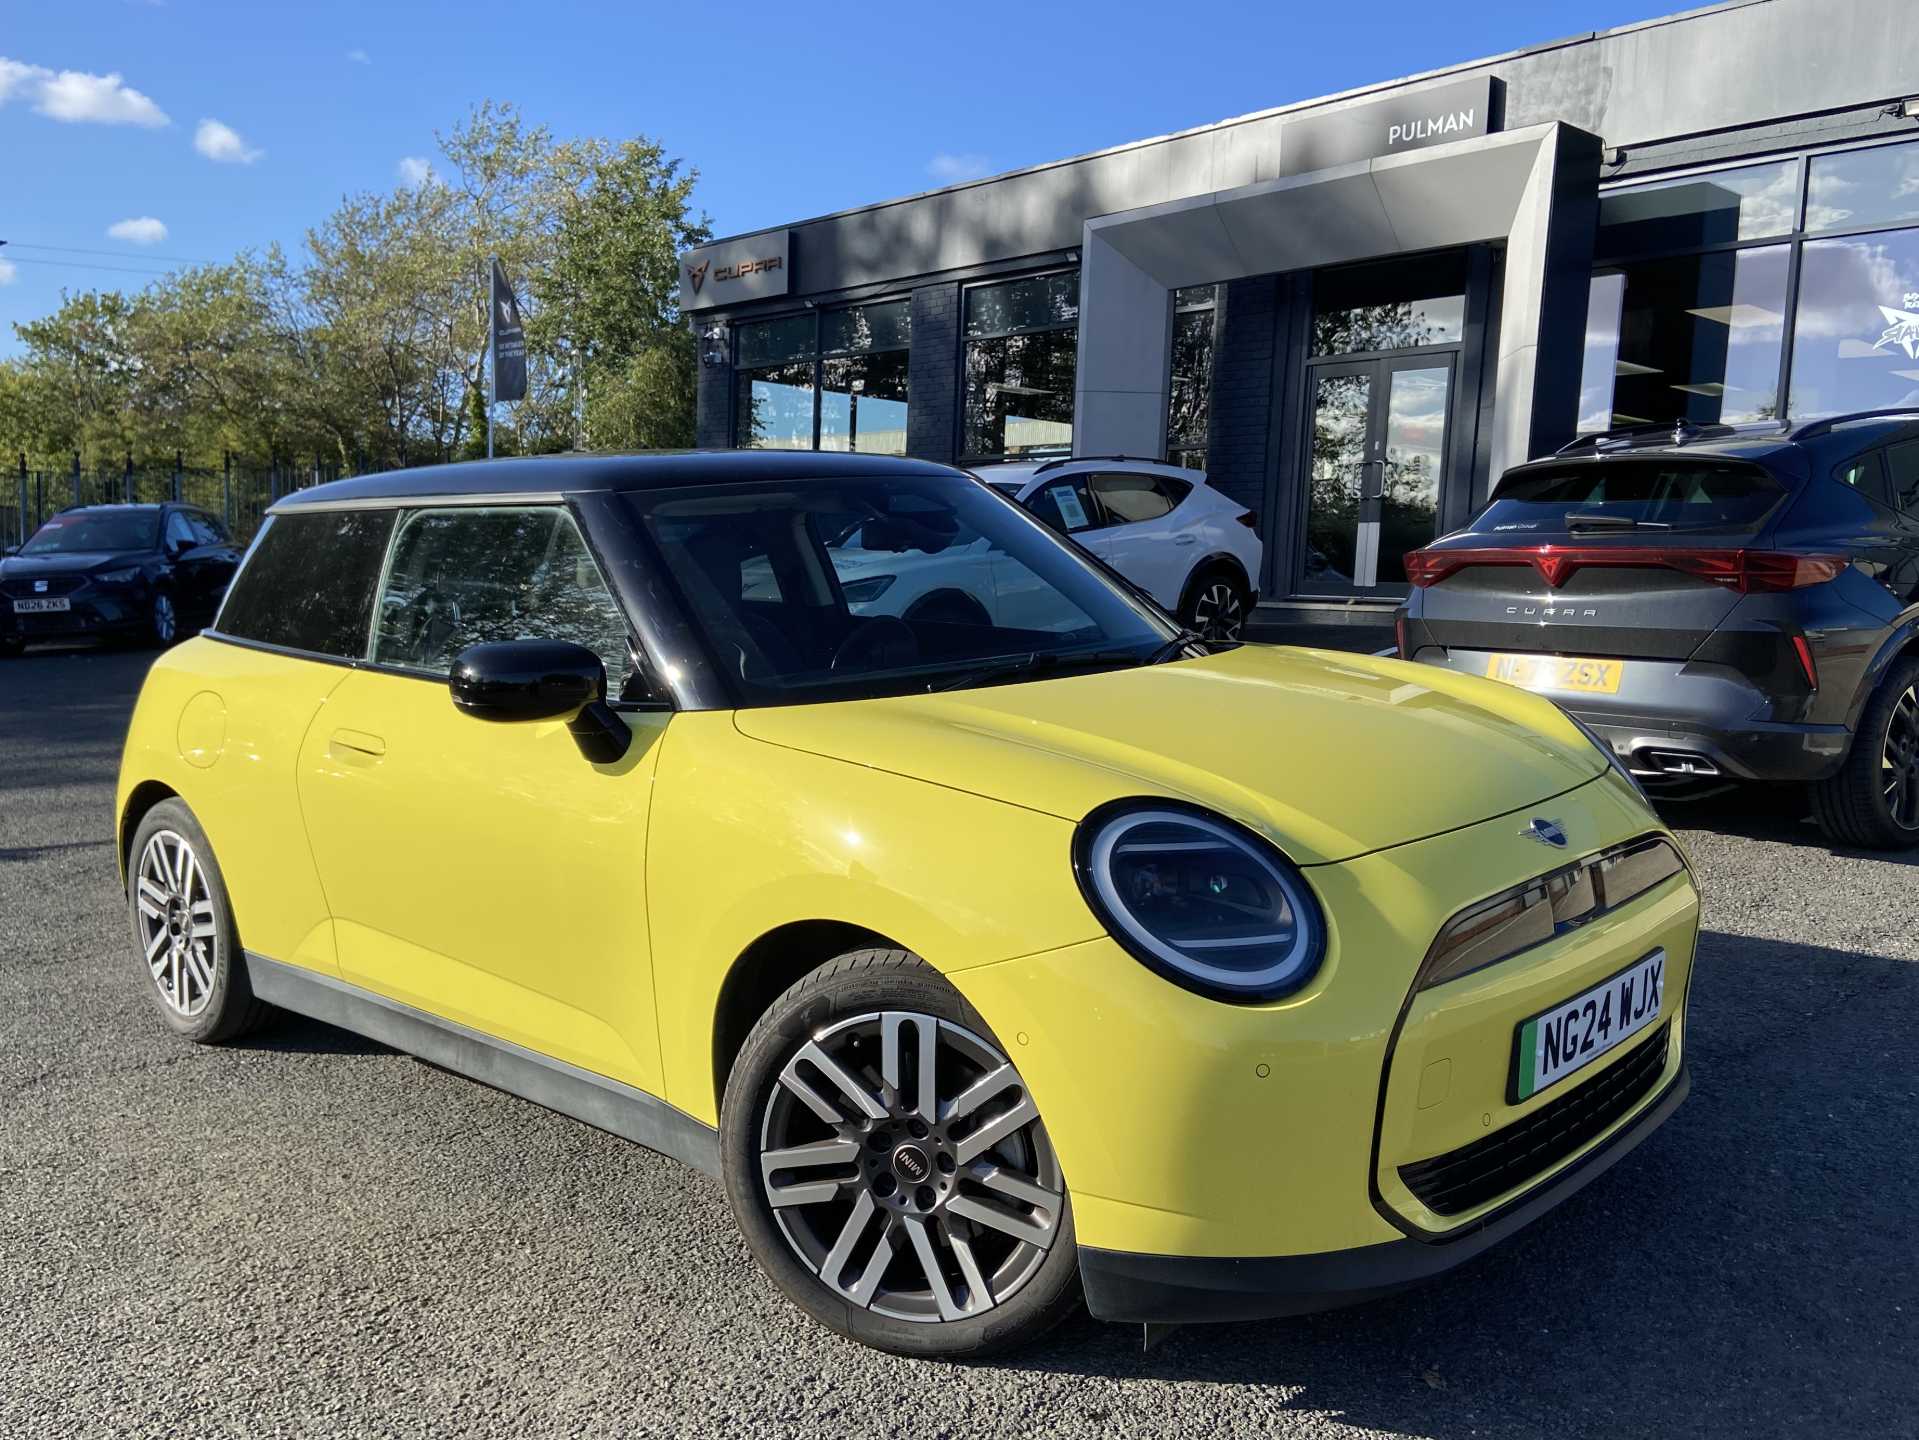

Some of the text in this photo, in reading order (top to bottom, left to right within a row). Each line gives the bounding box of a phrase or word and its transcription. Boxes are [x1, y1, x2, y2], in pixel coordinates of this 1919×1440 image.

[1388, 107, 1474, 145] PULMAN
[713, 256, 783, 282] CUPRA
[1506, 606, 1598, 617] CUPRA
[1562, 661, 1612, 688] ZSX
[1542, 960, 1663, 1076] NG24 WJX
[898, 1151, 923, 1176] MINI
